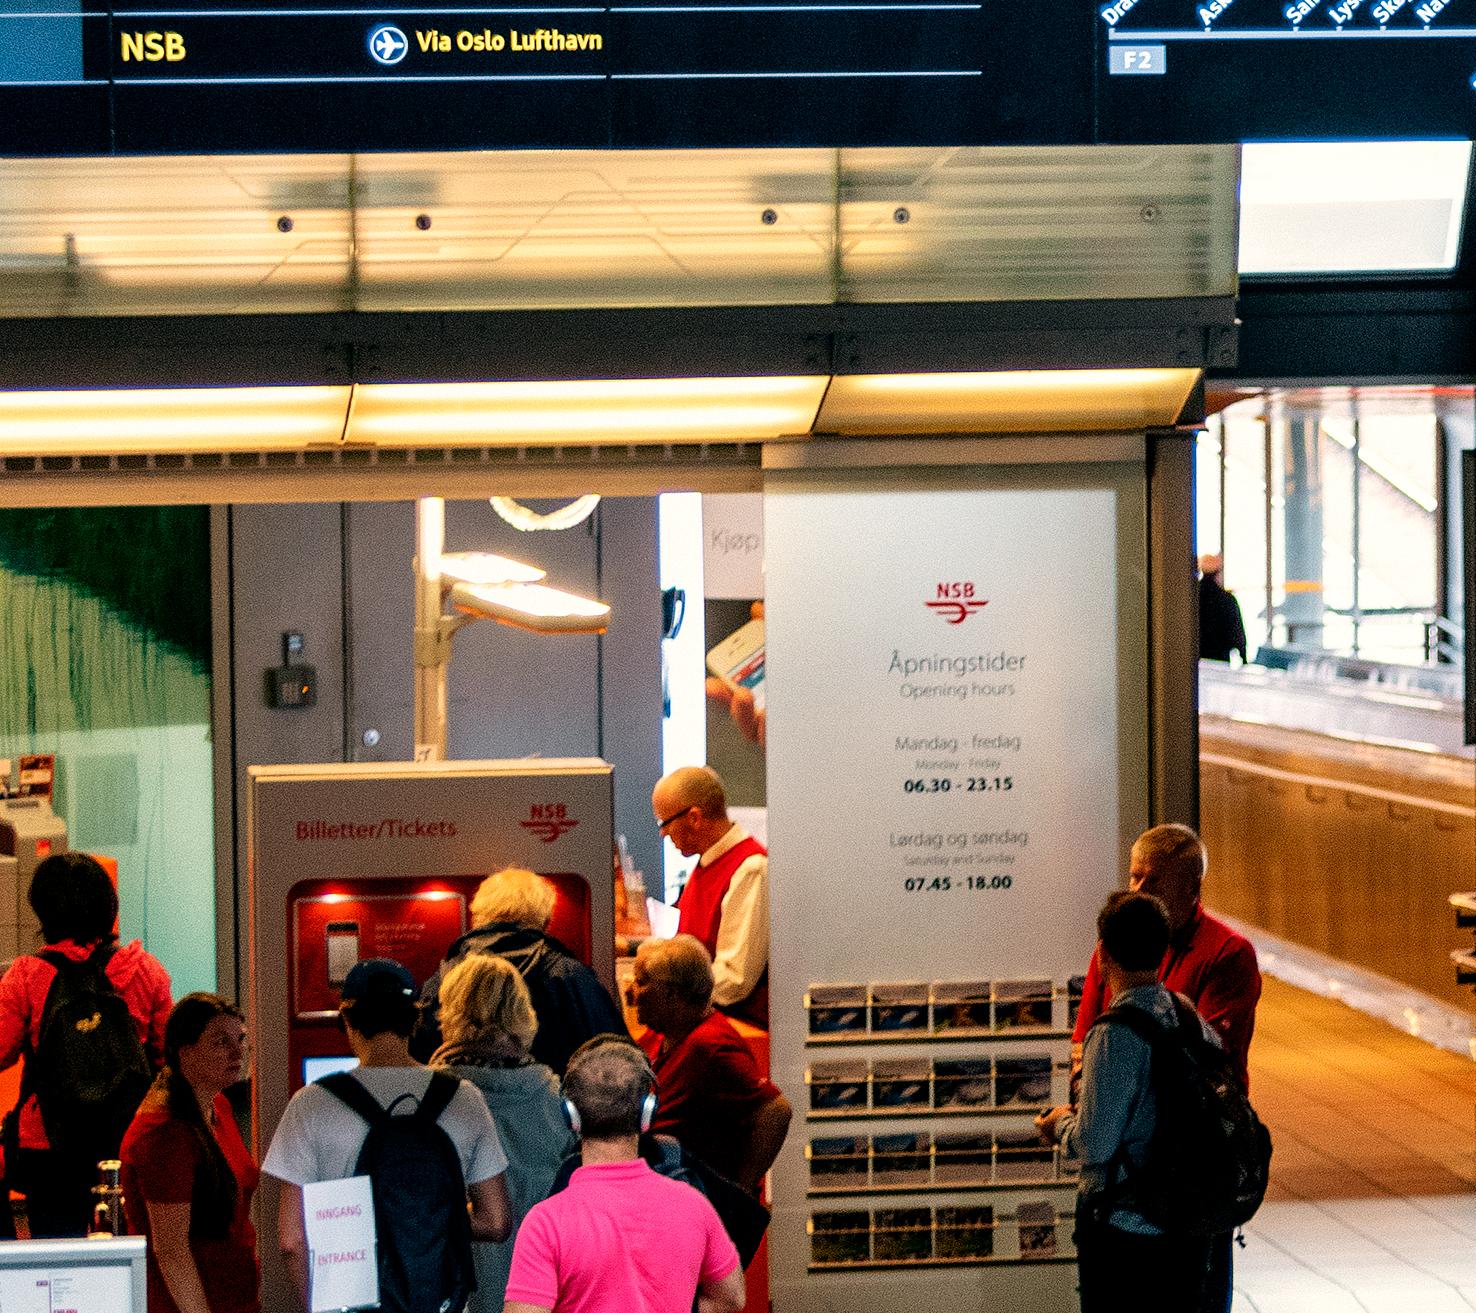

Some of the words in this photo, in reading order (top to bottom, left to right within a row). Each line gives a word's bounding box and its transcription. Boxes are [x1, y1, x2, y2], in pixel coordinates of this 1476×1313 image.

[937, 582, 975, 598] NSB
[888, 649, 1026, 676] Åpningstider
[900, 682, 967, 700] Opening
[972, 681, 1015, 697] hours
[895, 735, 957, 752] Mandag
[972, 734, 1020, 751] fredag
[904, 778, 951, 793] 06.30
[967, 776, 1013, 792] 23.15
[530, 804, 567, 821] NSB
[296, 818, 456, 841] Billetter/Tickets
[889, 832, 943, 849] Lørdag
[947, 835, 967, 850] og
[971, 830, 1028, 847] søndag
[905, 877, 951, 892] 07.45
[967, 875, 1012, 890] 18.00
